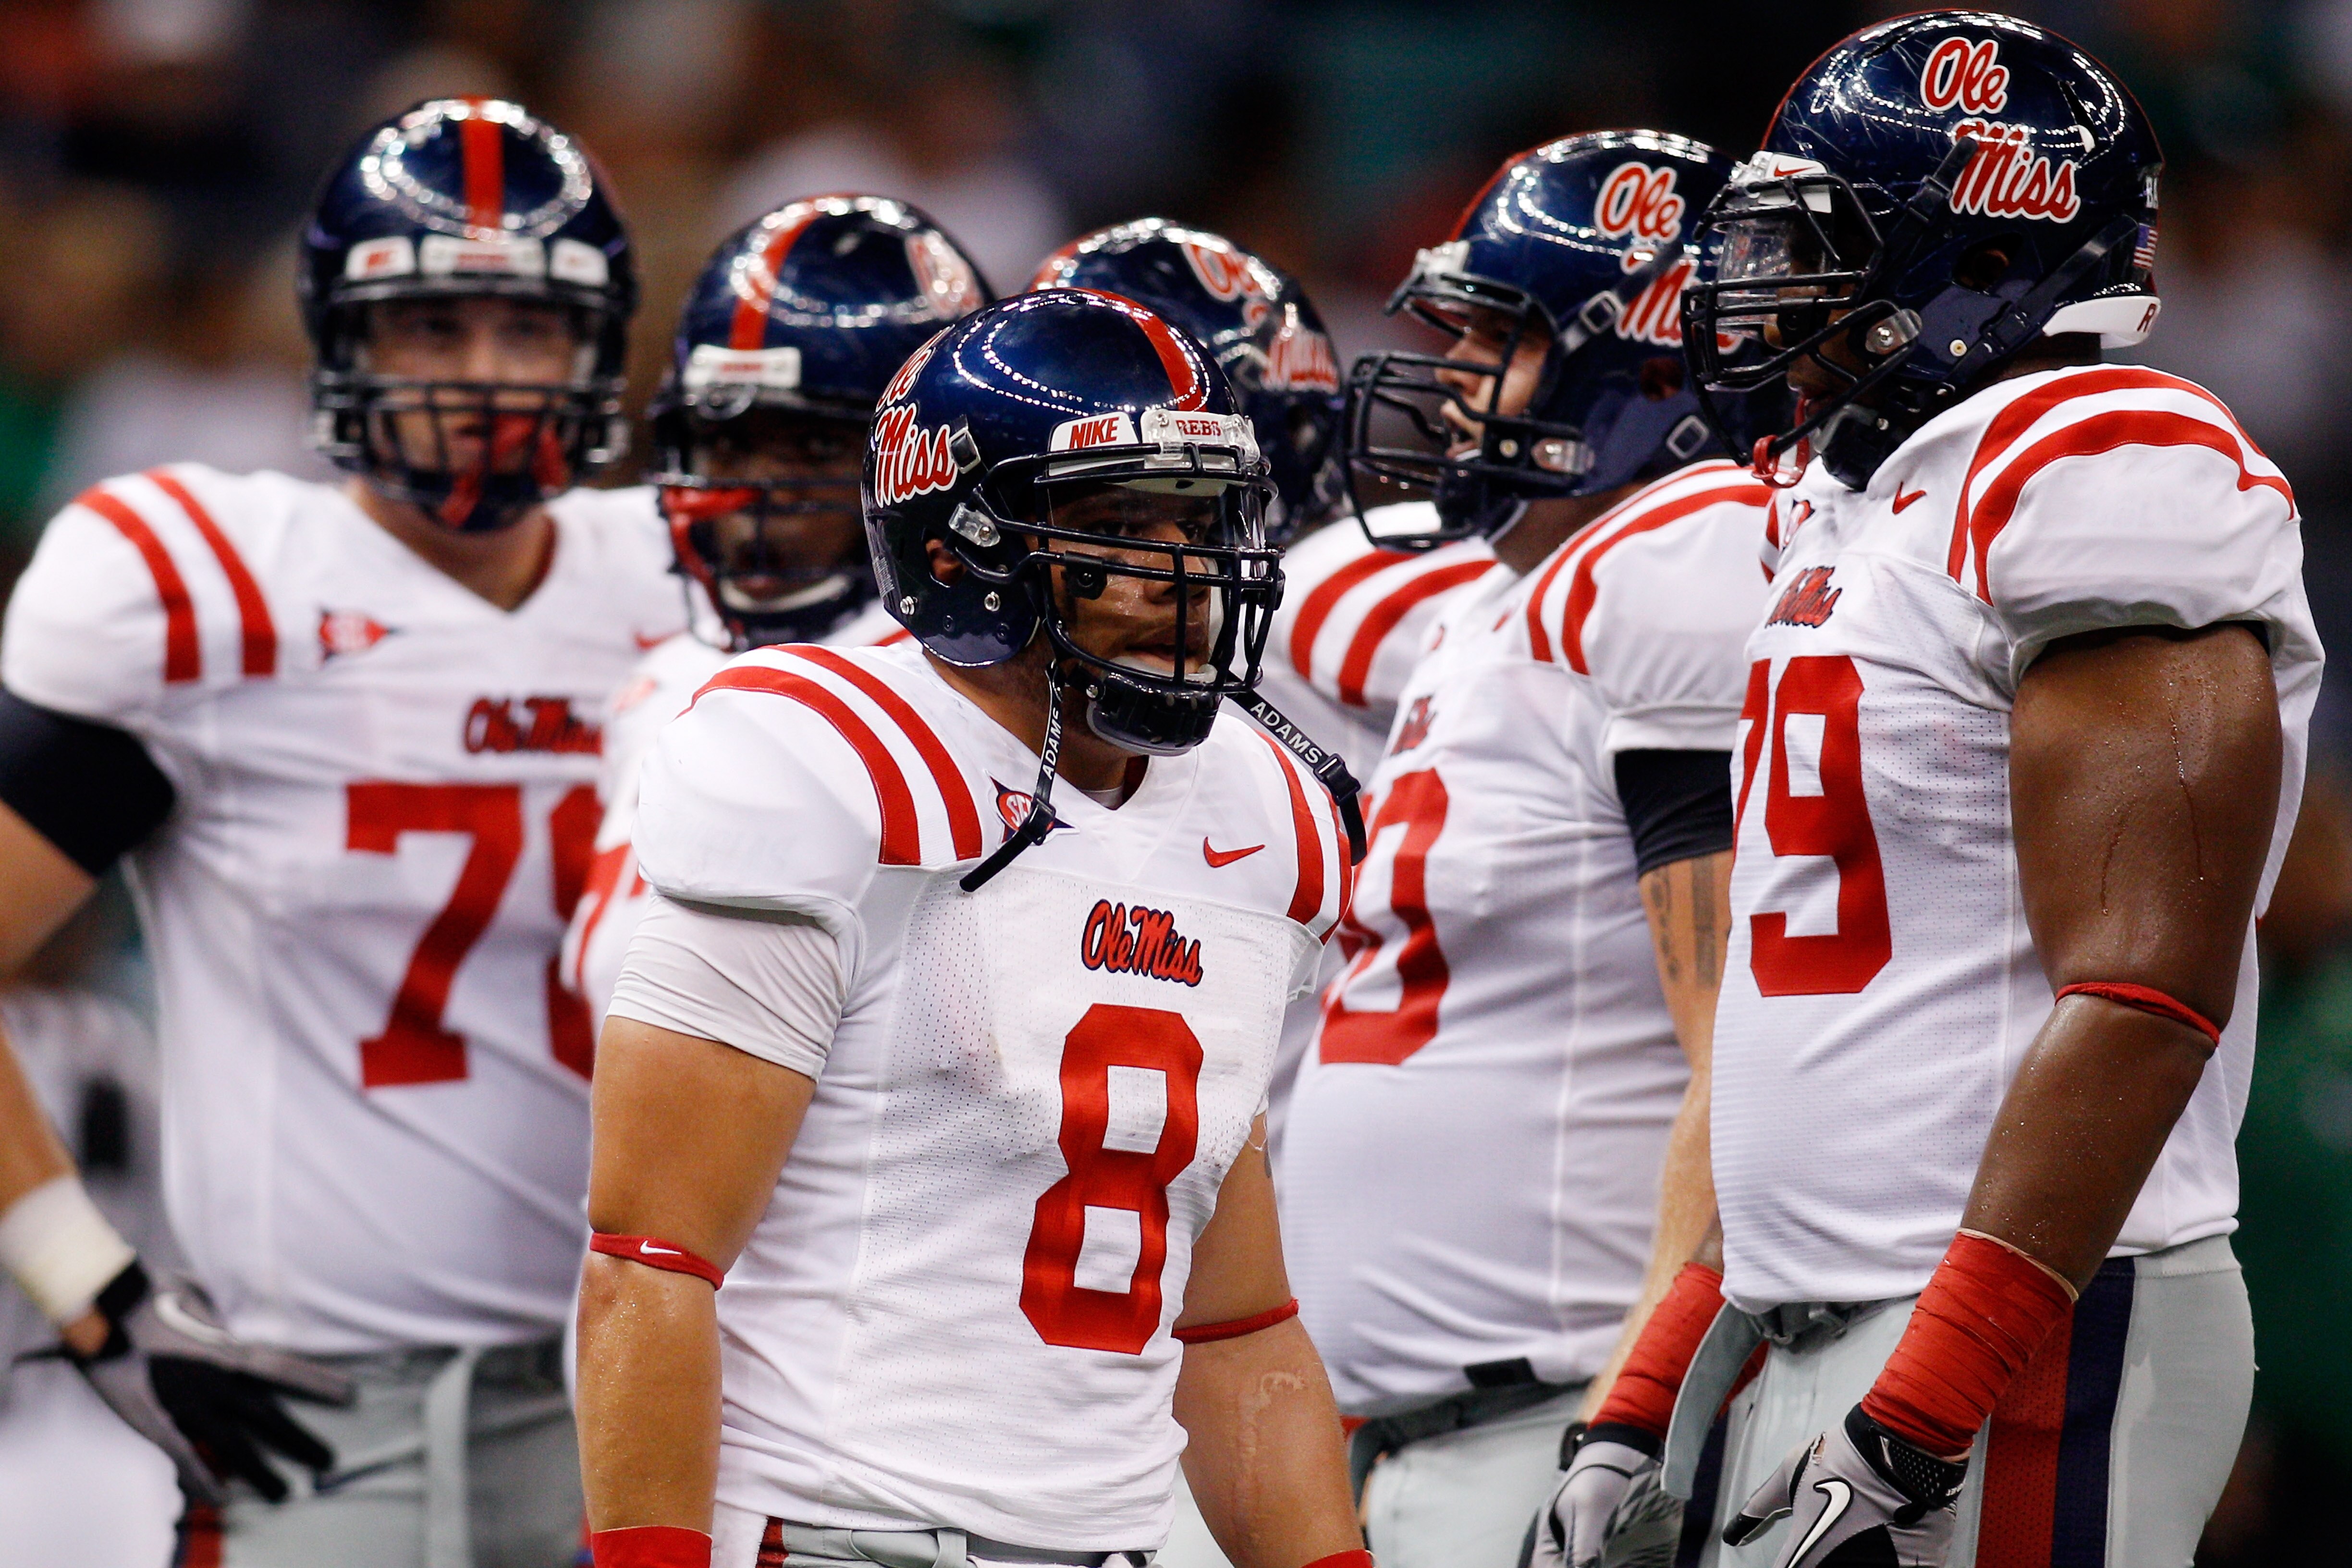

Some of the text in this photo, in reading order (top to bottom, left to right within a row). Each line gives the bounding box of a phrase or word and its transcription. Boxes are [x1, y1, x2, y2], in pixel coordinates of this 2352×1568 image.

[1920, 37, 2009, 114] Ole
[1595, 161, 1686, 244] Ole
[1941, 117, 2081, 223] Miss
[875, 403, 958, 508] Miss
[1069, 416, 1120, 449] NIKE
[1175, 419, 1221, 436] REBS
[1250, 701, 1322, 764] ADAMS
[345, 782, 598, 1090] 7
[1082, 899, 1203, 988] Ole Miss
[1019, 1003, 1204, 1356] 8
